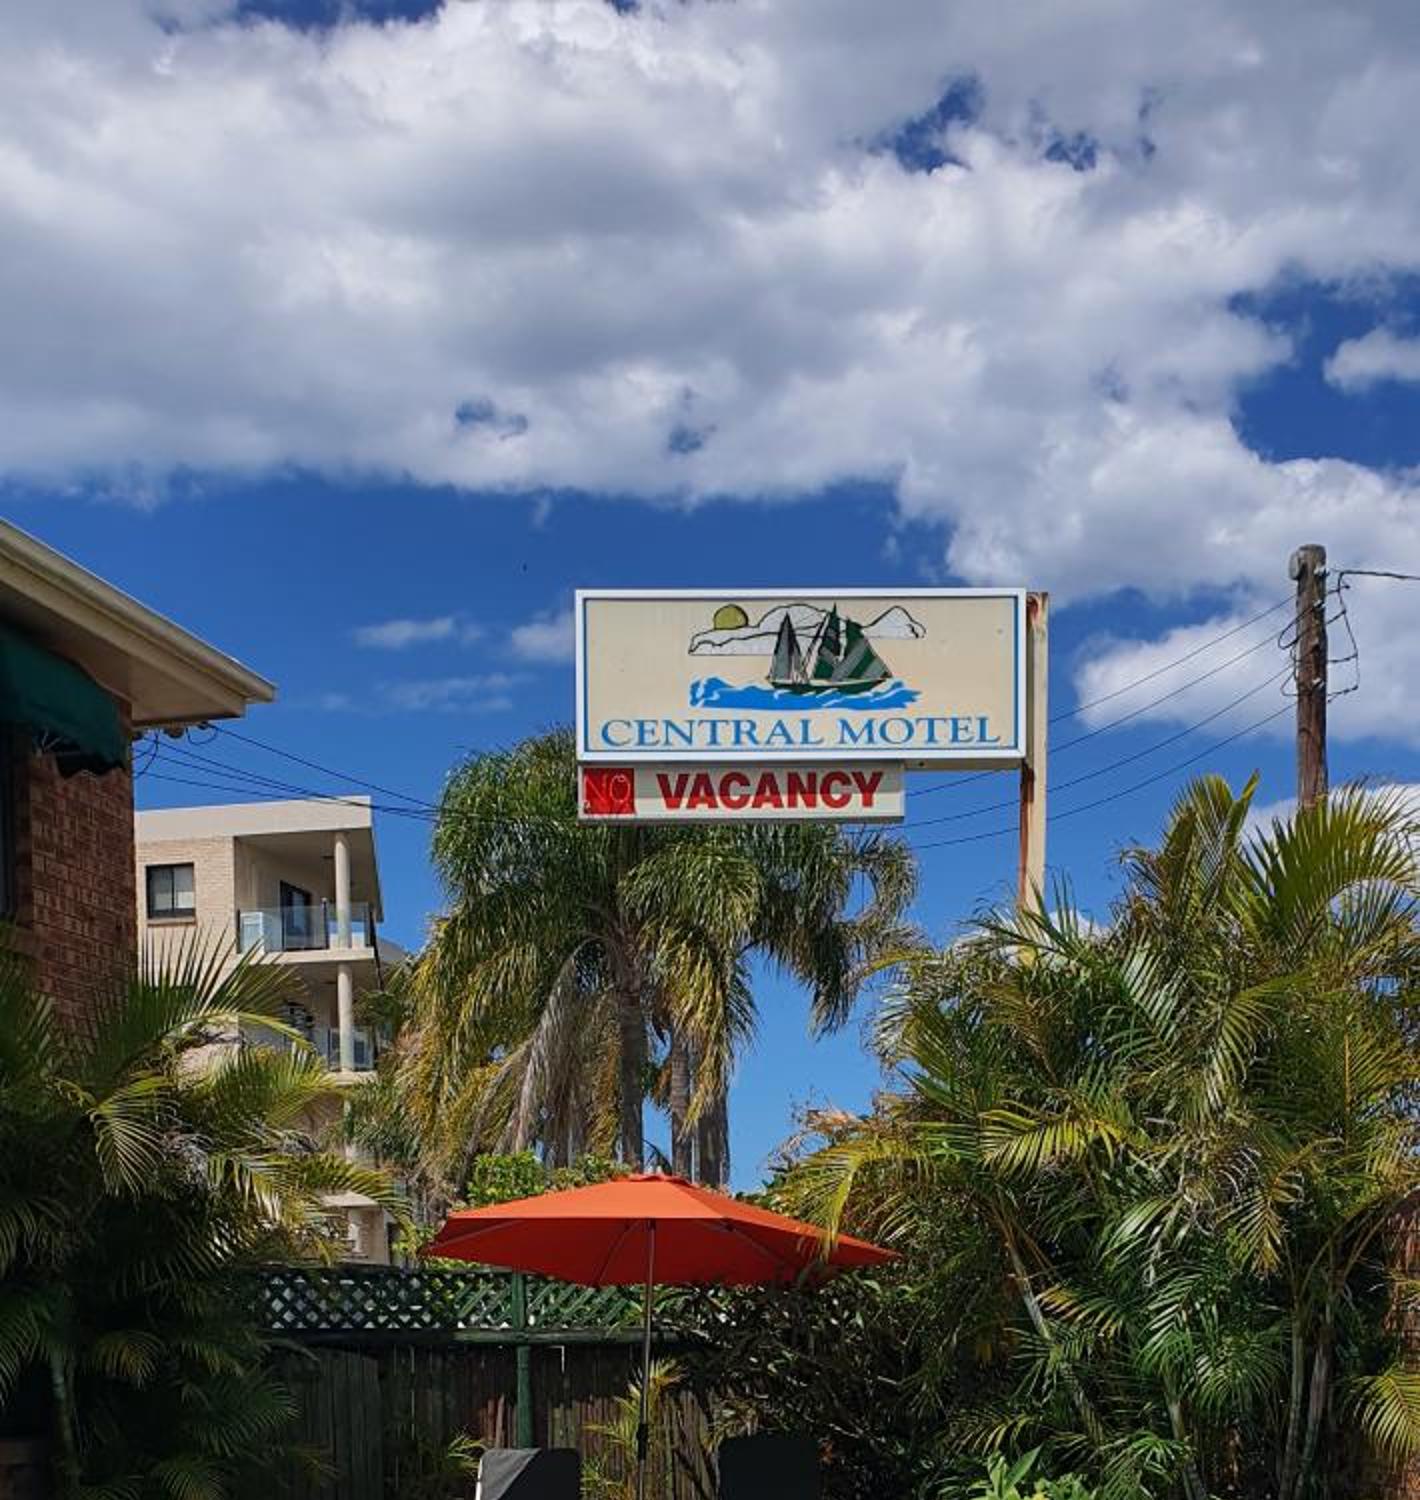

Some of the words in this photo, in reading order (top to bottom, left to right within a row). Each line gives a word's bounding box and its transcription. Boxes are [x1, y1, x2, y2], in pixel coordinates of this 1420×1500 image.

[601, 719, 825, 747] CENTRAL
[838, 716, 1001, 746] MOTEL
[584, 774, 631, 803] NO
[656, 770, 883, 810] VACANCY
